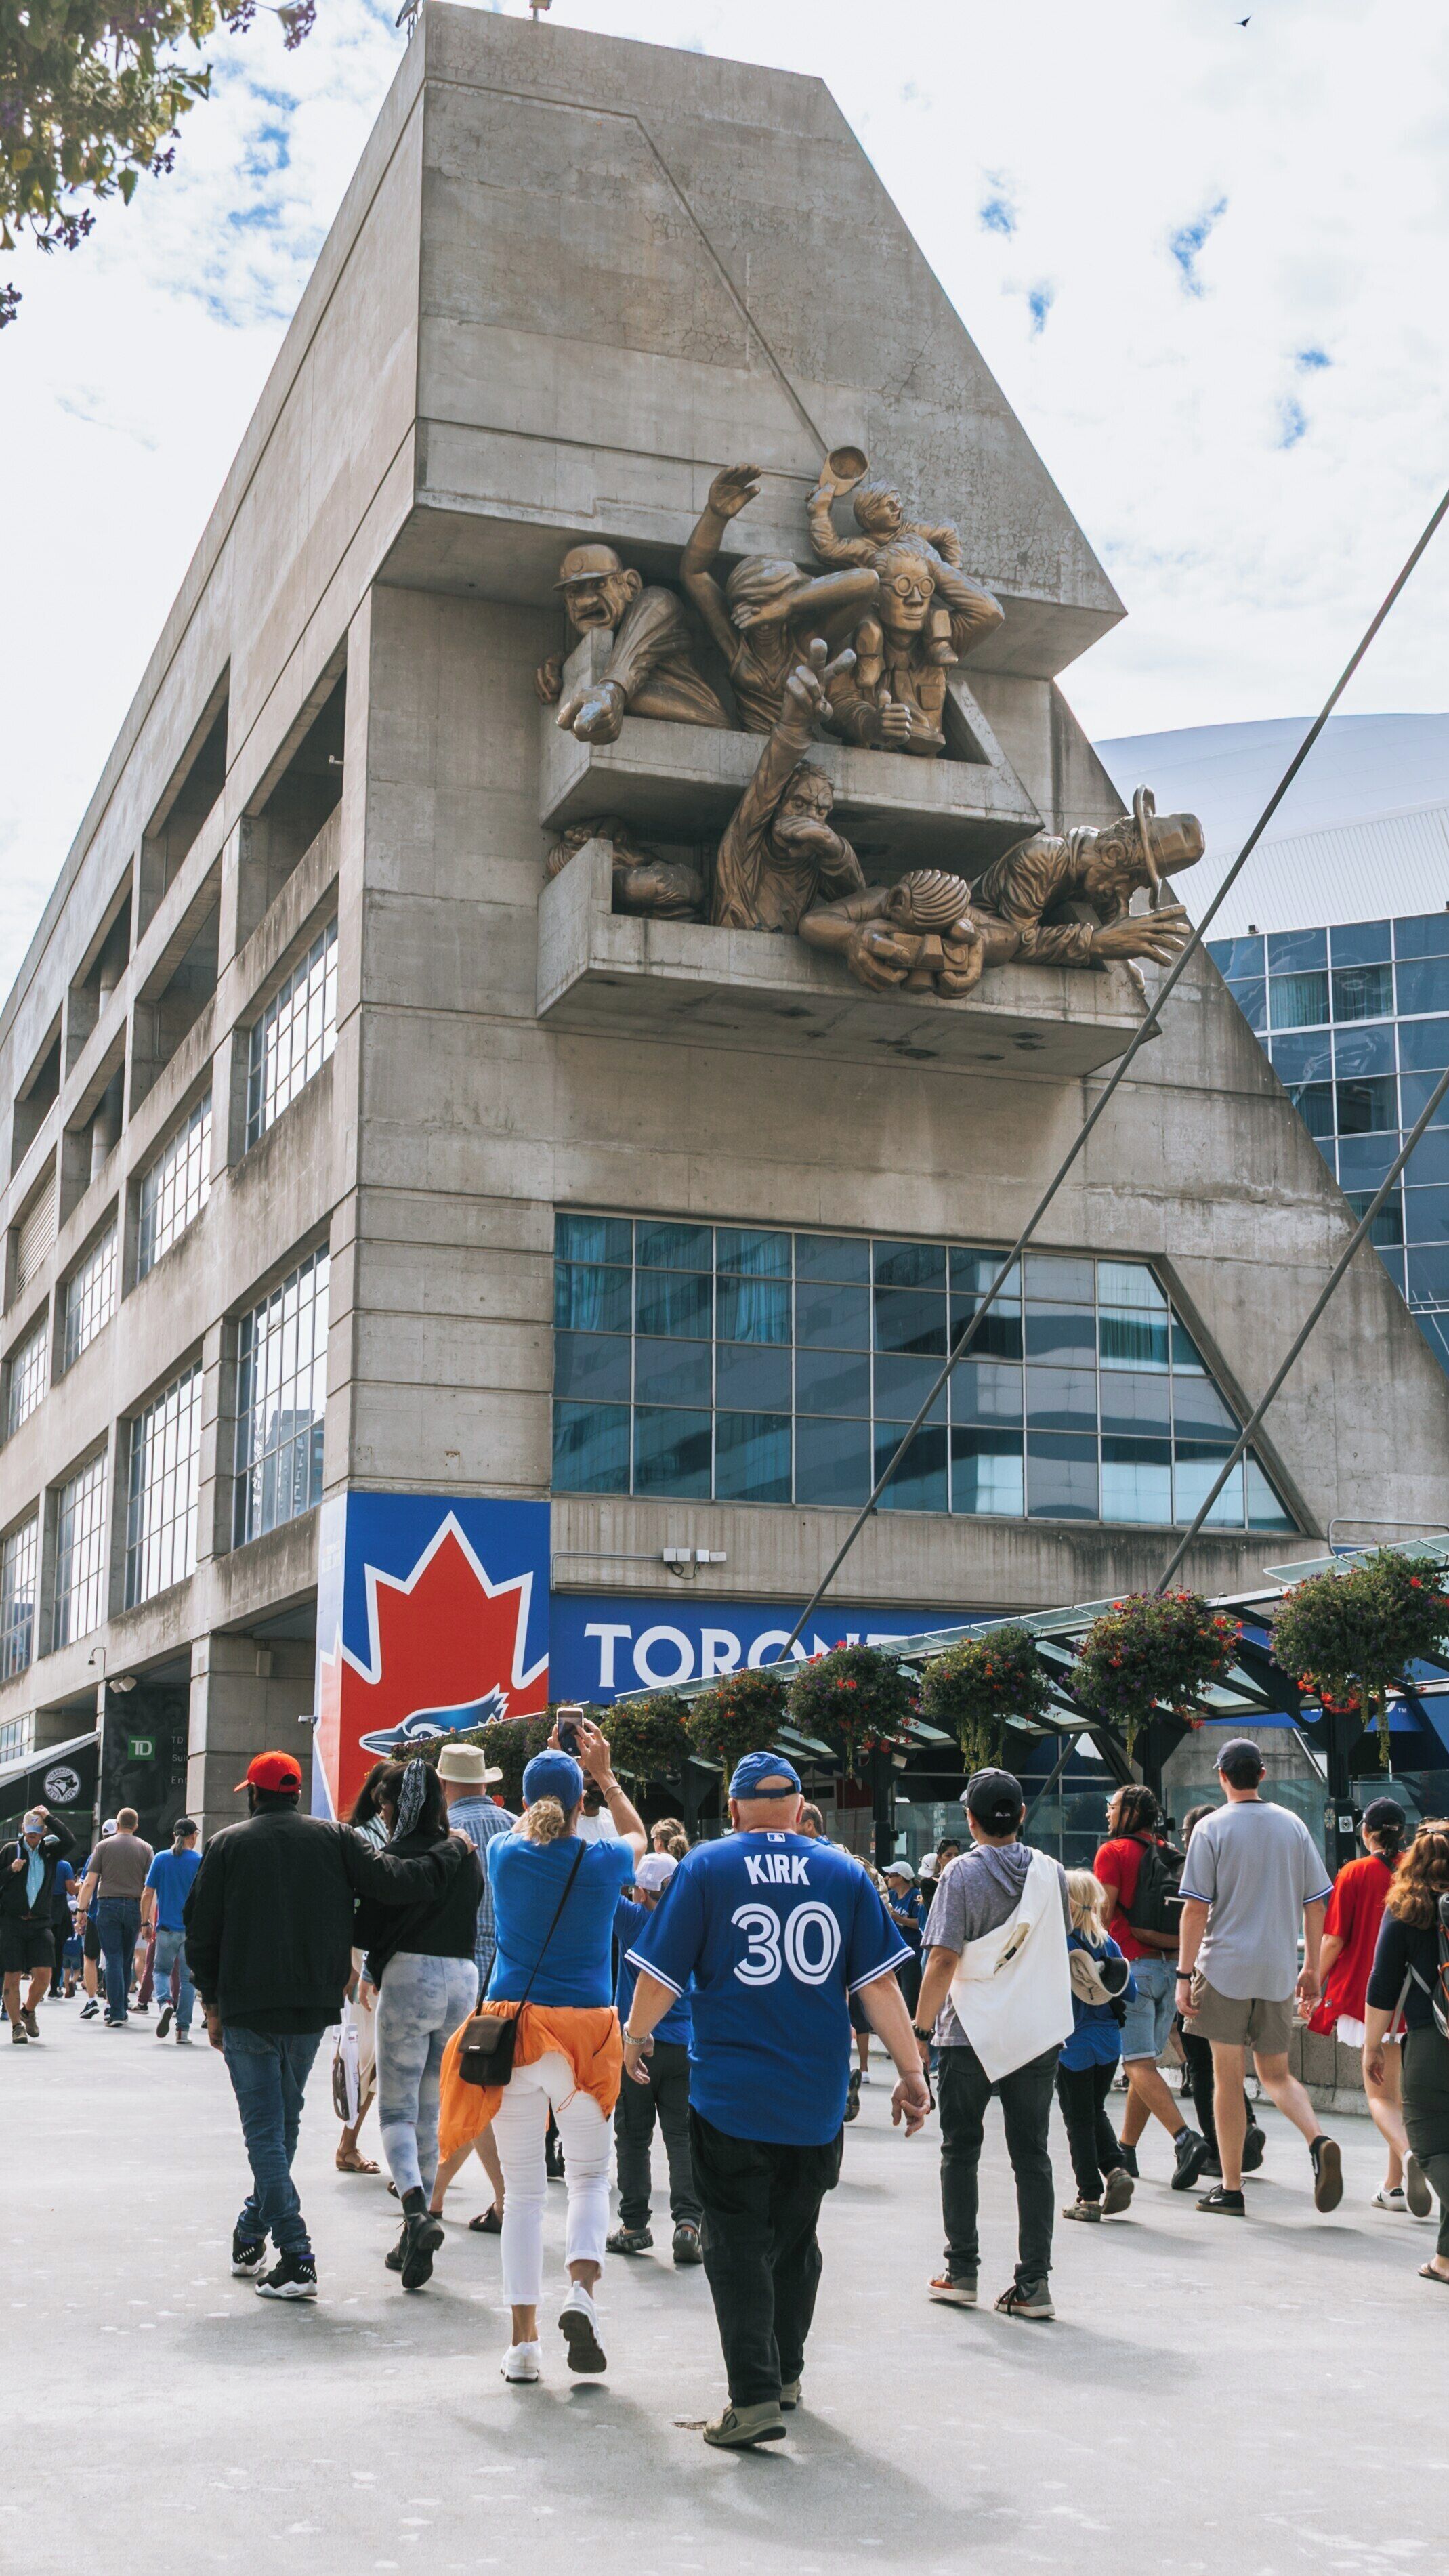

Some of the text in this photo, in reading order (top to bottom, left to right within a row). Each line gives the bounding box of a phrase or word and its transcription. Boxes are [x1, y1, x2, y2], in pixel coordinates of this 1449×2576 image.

[171, 1736, 184, 1744] TD
[131, 1740, 152, 1756] TD
[48, 1769, 71, 1780] TORONTO
[47, 1788, 77, 1801] BLUE JAYS
[744, 1854, 810, 1886] KIRK
[731, 1901, 841, 1985] 30
